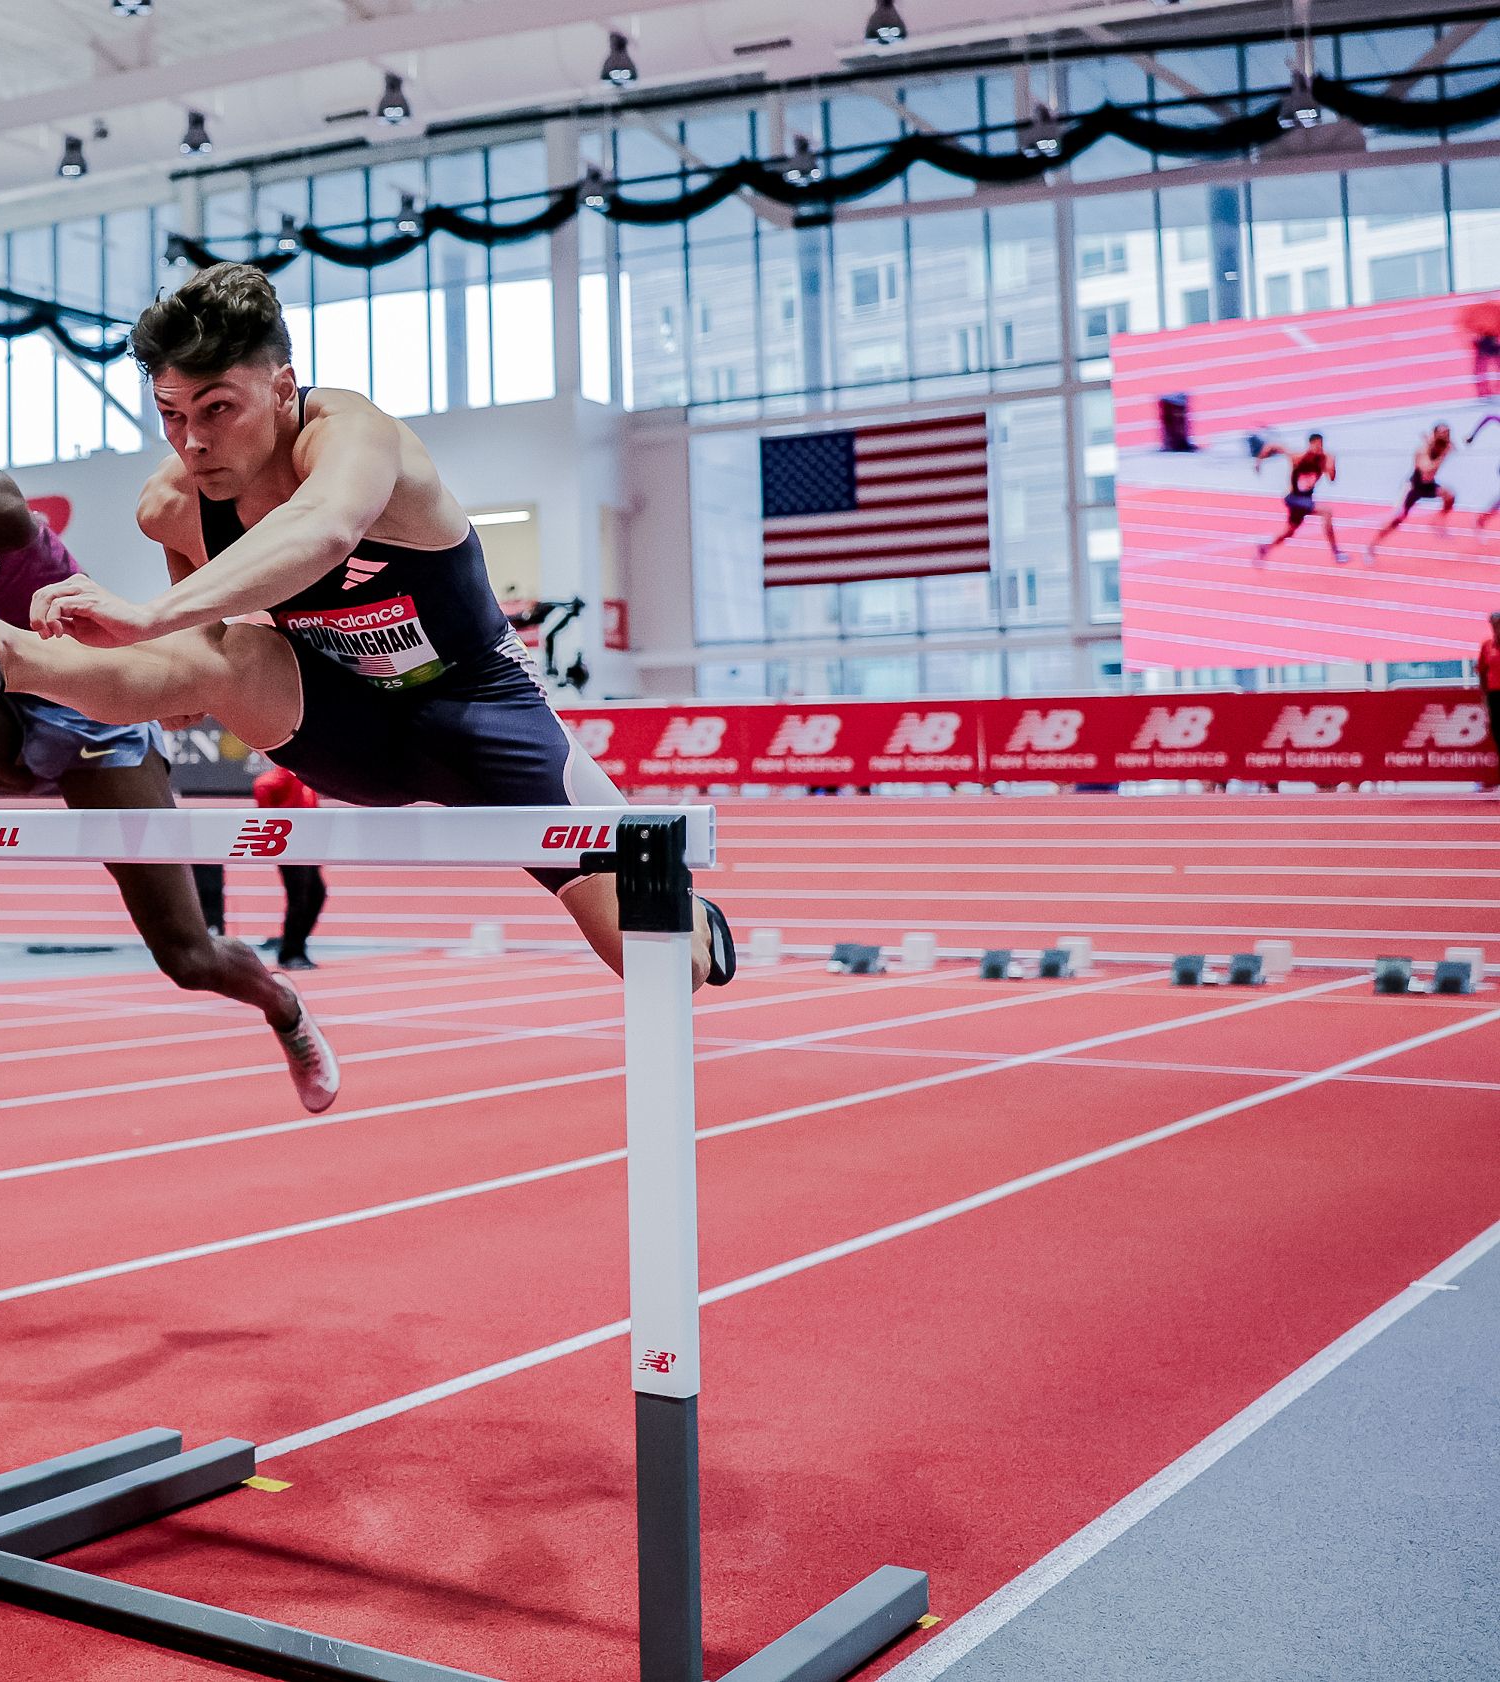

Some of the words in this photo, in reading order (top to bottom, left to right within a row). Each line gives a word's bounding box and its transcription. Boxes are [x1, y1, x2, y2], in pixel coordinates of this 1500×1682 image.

[288, 616, 323, 630] new
[654, 717, 727, 757] NB
[766, 714, 841, 755] NB
[884, 712, 961, 753] NB
[1005, 709, 1084, 751] NB
[1130, 706, 1213, 749] NB
[1262, 705, 1349, 748] NB
[1403, 703, 1488, 748] NB
[1428, 751, 1499, 768] balanc
[229, 819, 293, 857] NB
[541, 826, 612, 849] GILL
